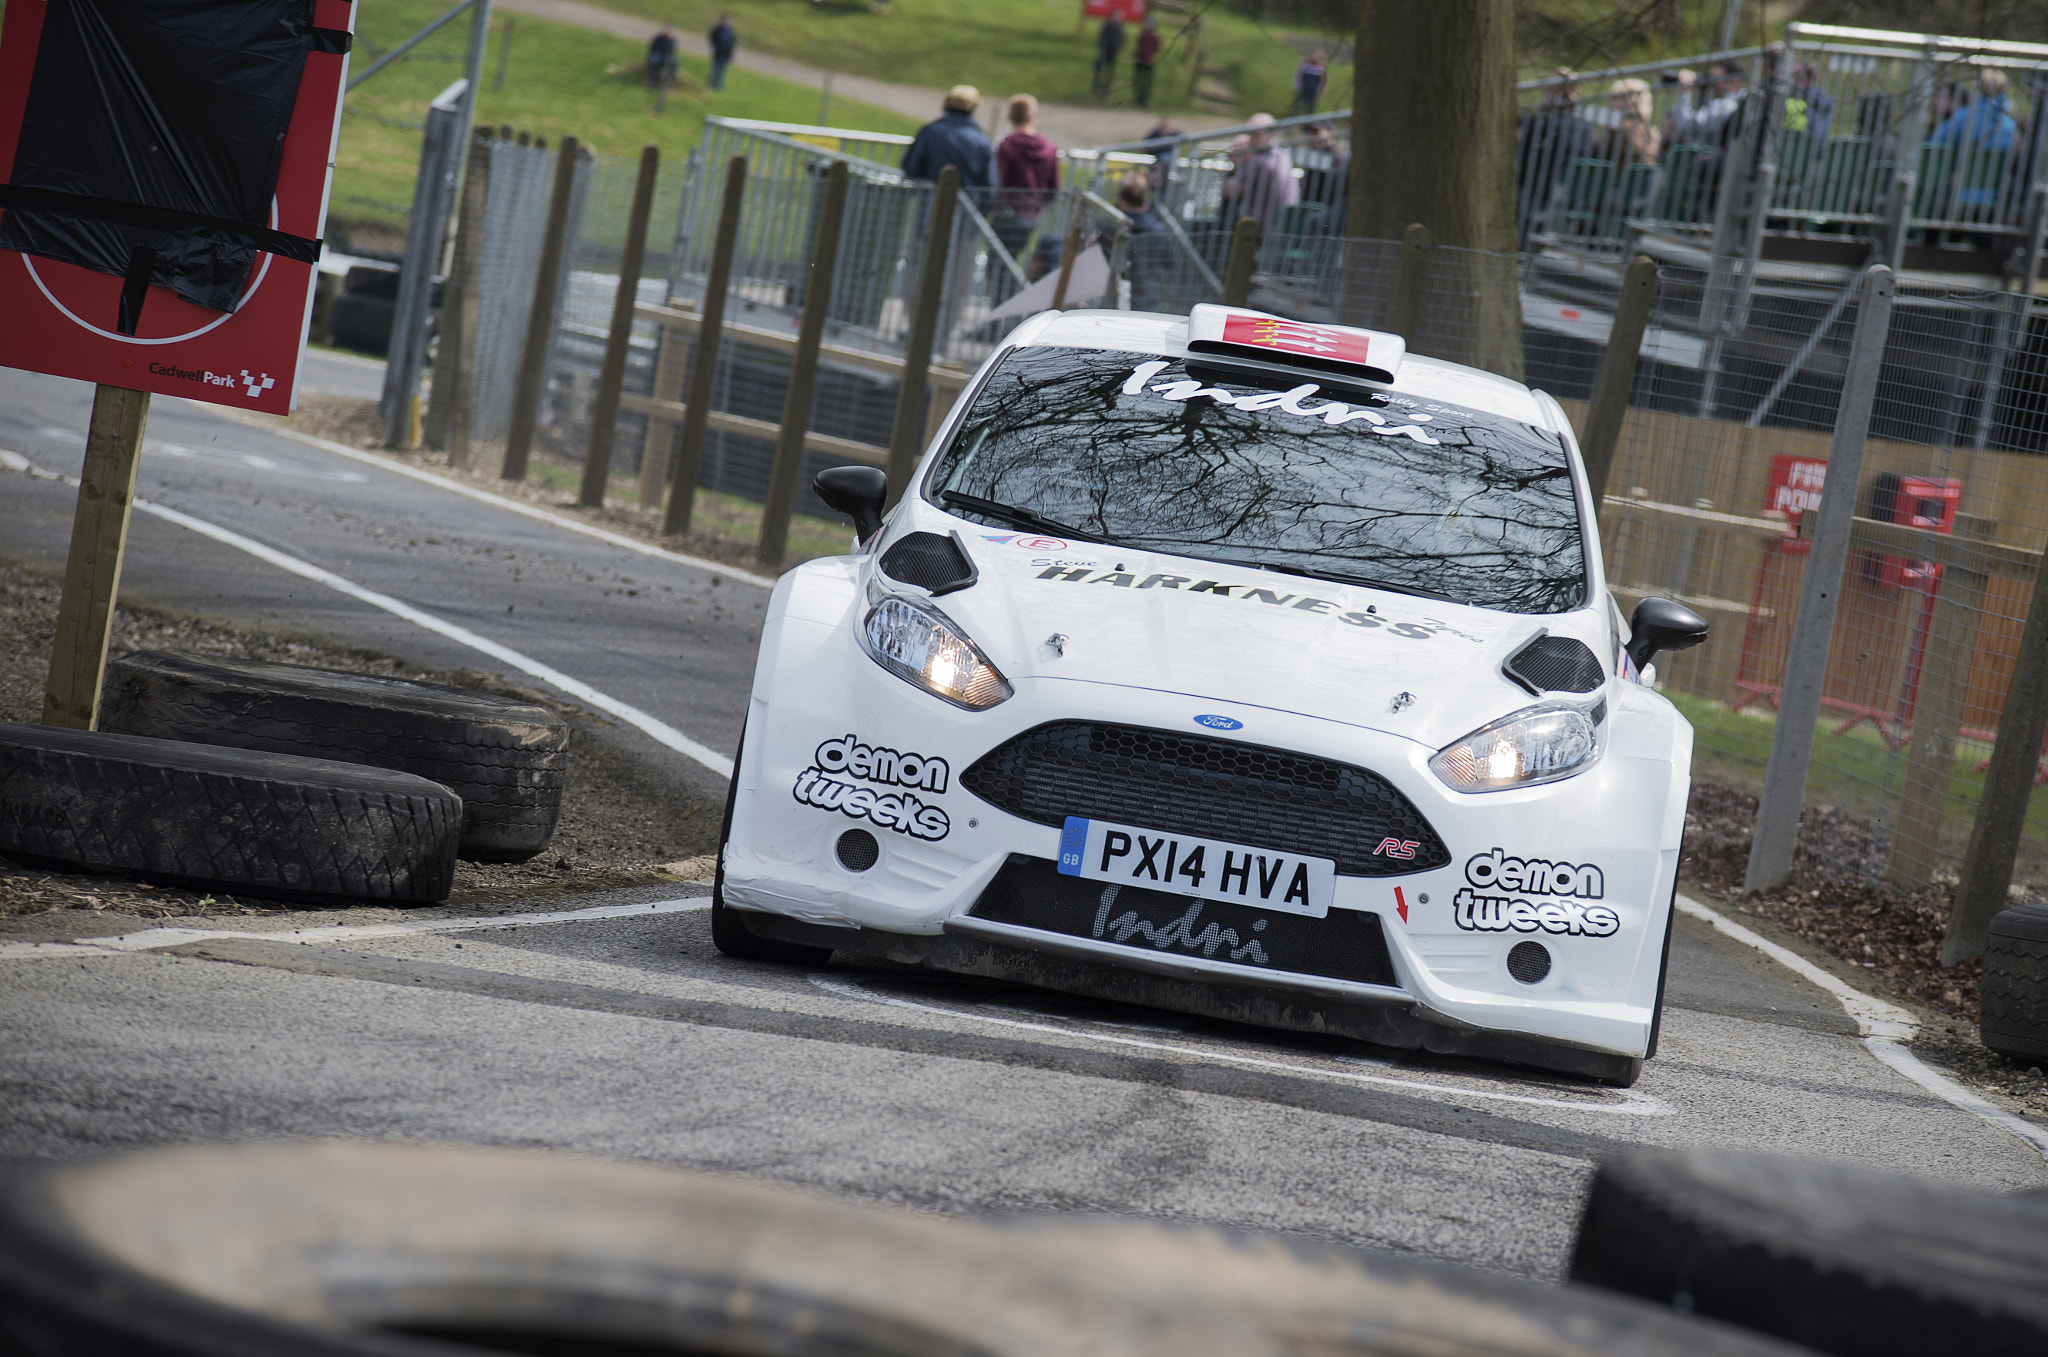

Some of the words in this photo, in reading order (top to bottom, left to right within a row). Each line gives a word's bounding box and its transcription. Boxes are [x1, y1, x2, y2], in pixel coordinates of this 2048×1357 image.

[148, 361, 236, 389] CadwellPark
[1122, 360, 1440, 446] Indri
[1370, 392, 1418, 409] Rally
[1424, 404, 1474, 419] Sport
[1030, 558, 1099, 567] Steve
[1035, 565, 1437, 640] HARKNESS
[1203, 715, 1234, 729] Ford
[815, 733, 950, 794] demon
[792, 765, 951, 842] tweeks
[1063, 852, 1080, 866] GB
[1100, 829, 1206, 888] PX14
[1219, 850, 1311, 907] HVA
[1372, 836, 1421, 860] RS
[1464, 846, 1605, 900] demon
[1092, 883, 1270, 965] Indri
[1453, 887, 1621, 938] tweeks
